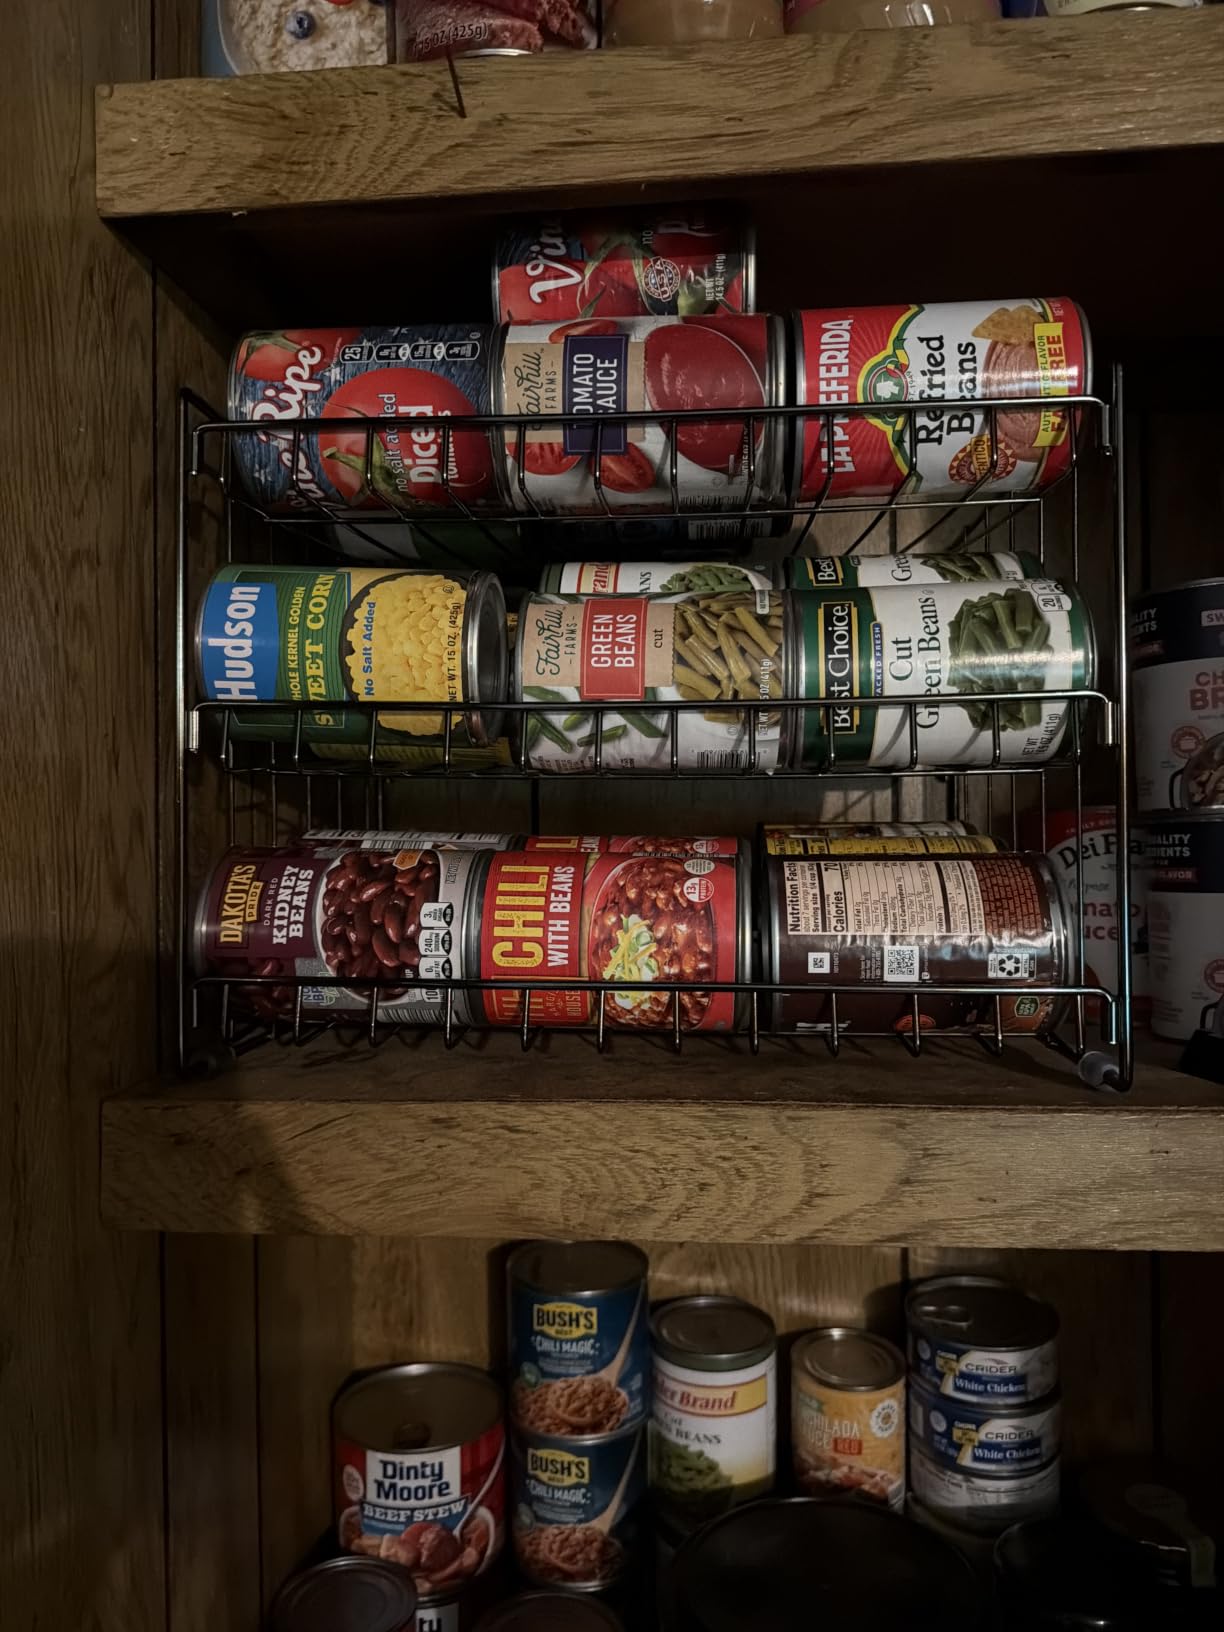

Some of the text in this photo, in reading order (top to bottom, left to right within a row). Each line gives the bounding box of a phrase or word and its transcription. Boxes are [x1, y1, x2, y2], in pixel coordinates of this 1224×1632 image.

[432, 22, 488, 47] OZ (425g)
[526, 224, 582, 304] Vin
[653, 257, 671, 300] USA
[344, 347, 362, 360] 25
[1036, 335, 1049, 371] FLAVOR
[252, 346, 322, 442] Ripe
[543, 370, 557, 409] FARMS
[916, 334, 947, 446] Refried
[1049, 405, 1066, 433] FA
[383, 449, 409, 493] no salt
[820, 446, 857, 474] LA
[639, 571, 652, 593] ANS
[814, 558, 837, 581] Best
[305, 574, 336, 631] CORN
[448, 602, 461, 629] (425g)
[1042, 597, 1057, 608] 20
[535, 609, 564, 676] Fairhill
[564, 622, 578, 656] FARMS
[590, 614, 614, 668] GREEN
[614, 614, 638, 668] BEANS
[652, 628, 664, 649] cut
[828, 605, 850, 678] Choice
[916, 597, 941, 654] Beans
[207, 586, 262, 701] Hudson
[287, 586, 306, 701] HOLE KERNEL GOLDEN
[362, 601, 376, 697] No Salt Added
[447, 651, 457, 661] 15
[888, 637, 913, 682] Cut
[447, 665, 457, 681] WT.
[760, 658, 773, 683] (411g)
[875, 660, 883, 697] ACKED
[447, 685, 458, 702] NET
[759, 684, 769, 694] OZ
[1044, 713, 1060, 737] (411g)
[580, 836, 601, 852] EAN
[1058, 836, 1100, 870] Dei
[219, 863, 257, 944] DAKOTA'S
[247, 883, 261, 919] PRIDE
[263, 877, 279, 926] DARK RED
[272, 864, 300, 945] KIDNEY
[289, 869, 314, 938] BEANS
[549, 865, 576, 913] BEANS
[786, 862, 801, 932] Nutrition Facts
[810, 893, 818, 905] size
[824, 862, 845, 933] Calories 70
[491, 864, 551, 968] CHILI
[811, 906, 820, 933] Serving
[547, 919, 570, 967] WITH
[536, 1307, 594, 1330] BUSH'S
[954, 1376, 1026, 1394] White Chicken
[965, 1362, 1018, 1374] CRIDER
[679, 1390, 737, 1410] Brand
[675, 1428, 721, 1444] BEANS
[984, 1429, 1034, 1441] CRIDER
[530, 1453, 585, 1479] BUSH'S
[973, 1446, 1004, 1460] White
[379, 1459, 444, 1482] Dinty
[374, 1480, 453, 1501] Moore
[362, 1498, 468, 1523] BEEF STEW
